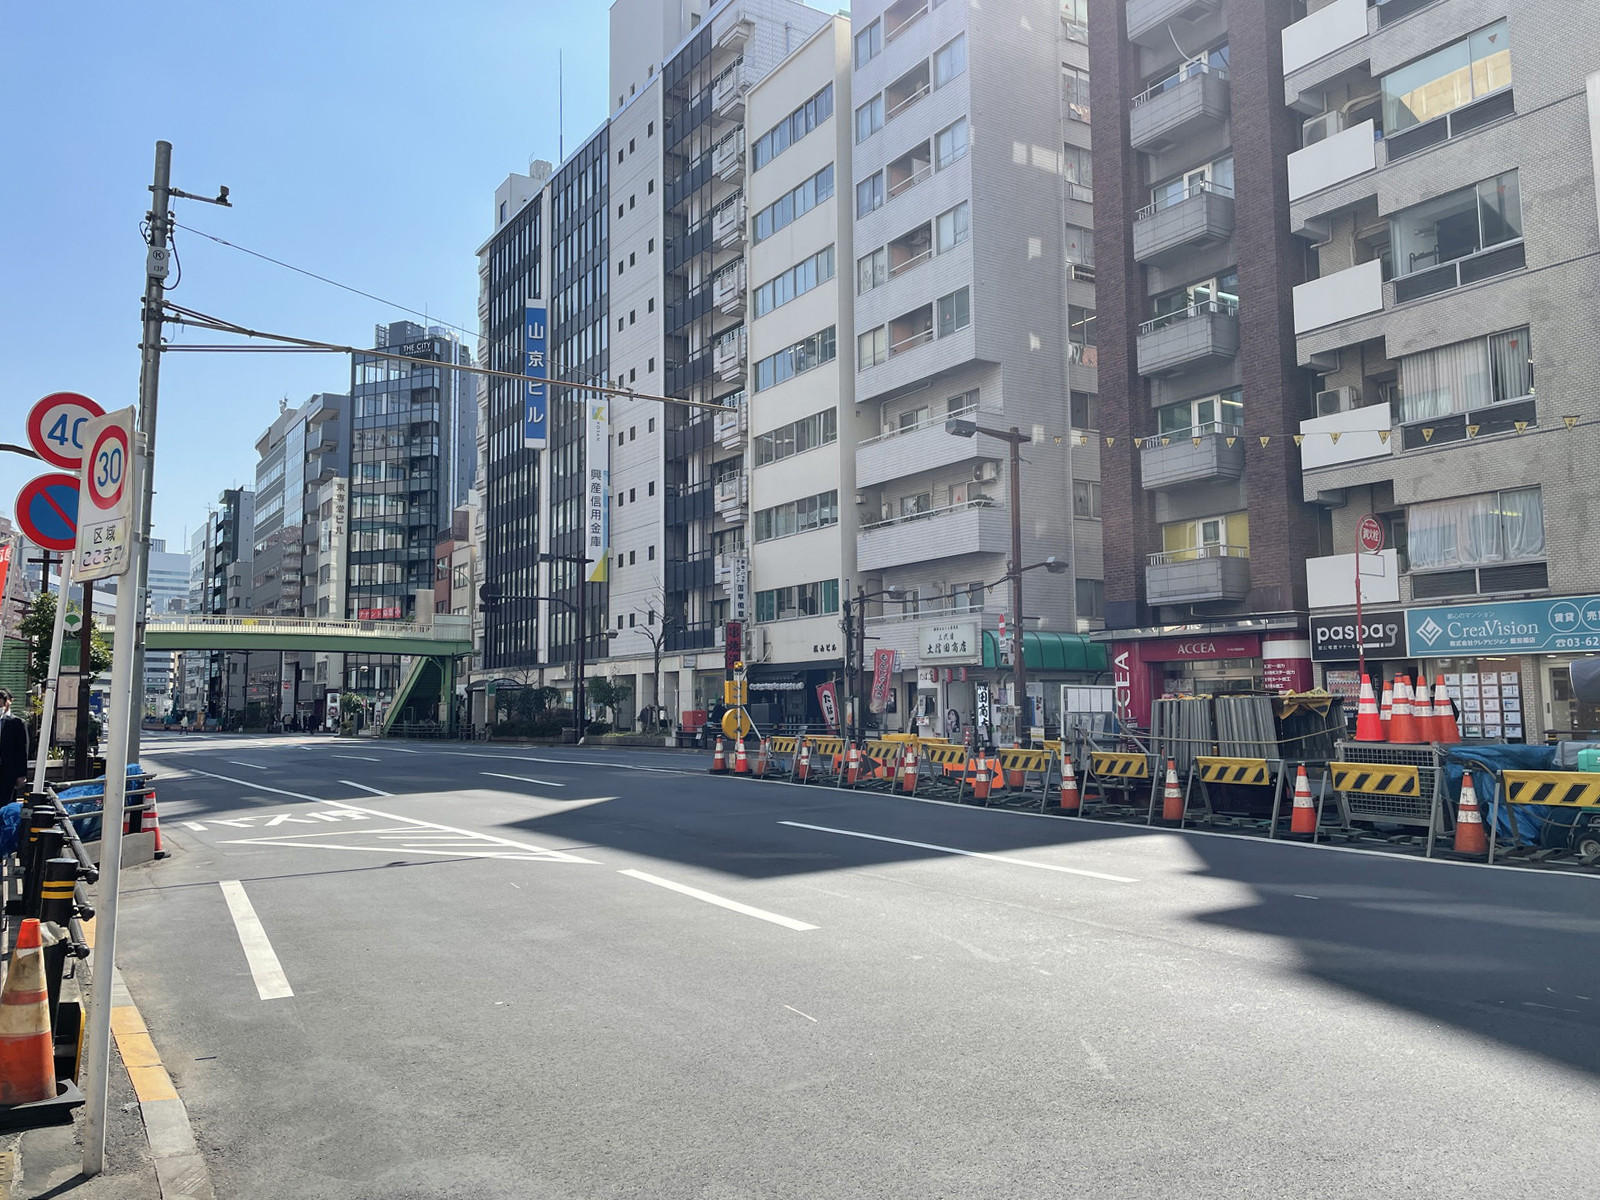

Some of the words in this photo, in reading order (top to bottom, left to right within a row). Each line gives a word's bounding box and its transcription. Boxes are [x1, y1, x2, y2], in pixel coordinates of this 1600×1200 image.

[403, 344, 415, 352] THE
[416, 342, 431, 350] CITY
[528, 322, 544, 423] 山京ビル
[97, 447, 122, 487] 30
[590, 469, 602, 547] 興産信用金庫
[94, 525, 116, 544] 区域
[83, 545, 124, 567] ここまで
[1586, 610, 1600, 621] 売
[1447, 620, 1540, 638] CreaVision
[1177, 642, 1216, 654] ACCEA
